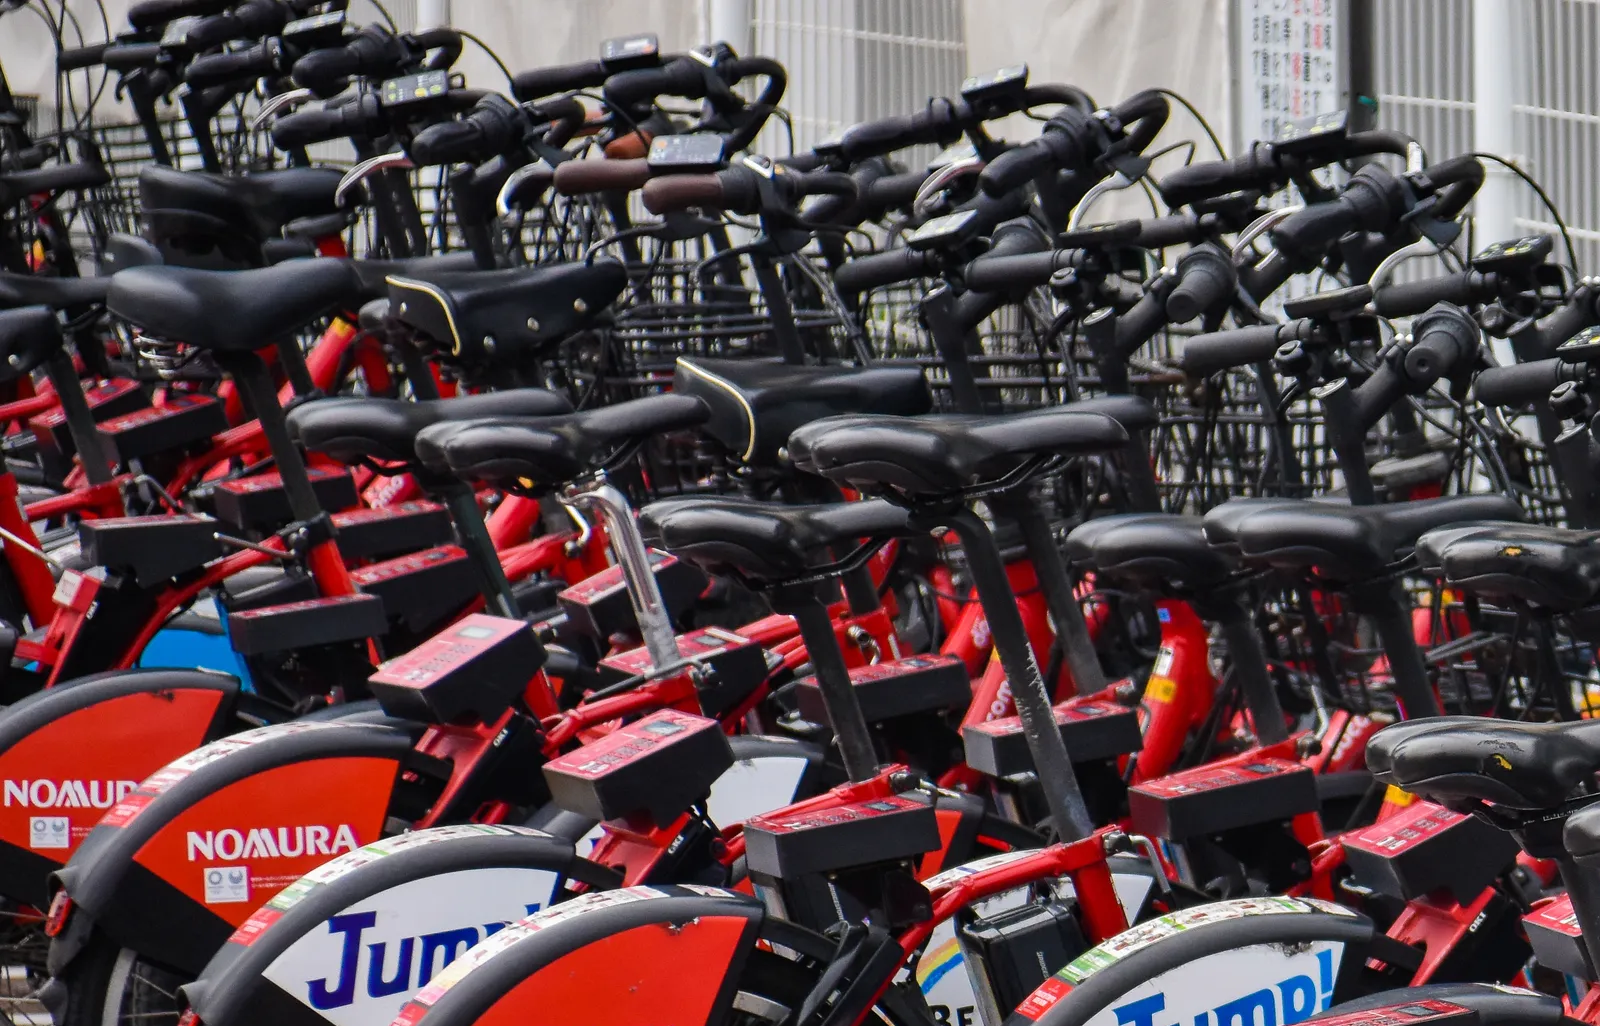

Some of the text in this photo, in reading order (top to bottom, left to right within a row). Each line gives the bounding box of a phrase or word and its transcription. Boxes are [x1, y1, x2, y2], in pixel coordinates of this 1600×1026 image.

[187, 824, 358, 861] NOMURA
[1469, 911, 1487, 932] OKI
[307, 903, 541, 1011] Jum
